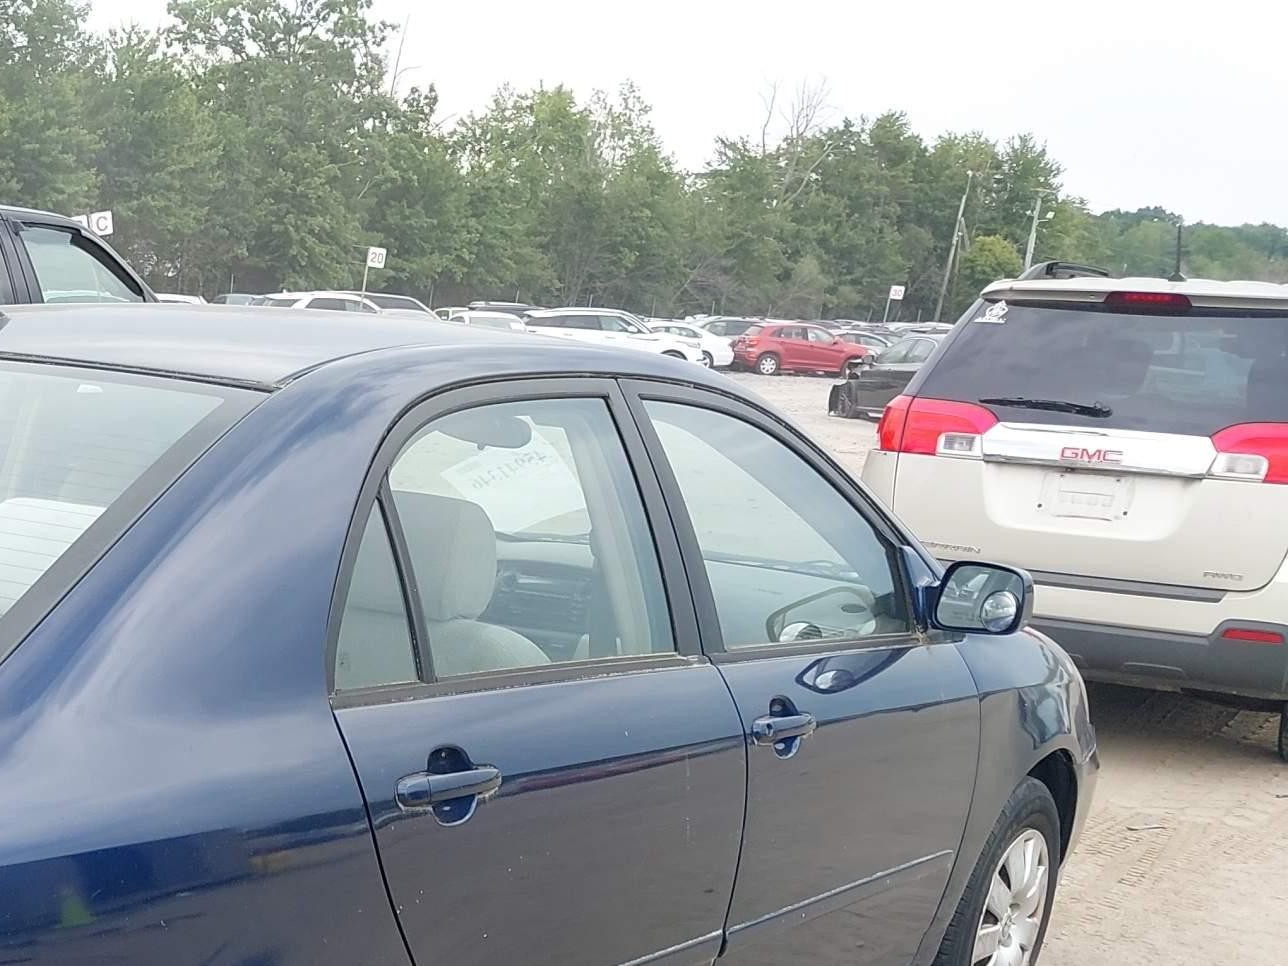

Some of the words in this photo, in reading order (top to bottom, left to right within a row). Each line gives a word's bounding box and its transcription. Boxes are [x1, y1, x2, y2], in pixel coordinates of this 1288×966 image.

[96, 215, 109, 232] C
[369, 251, 384, 264] 20
[891, 288, 903, 298] 30
[1059, 446, 1124, 463] GMC
